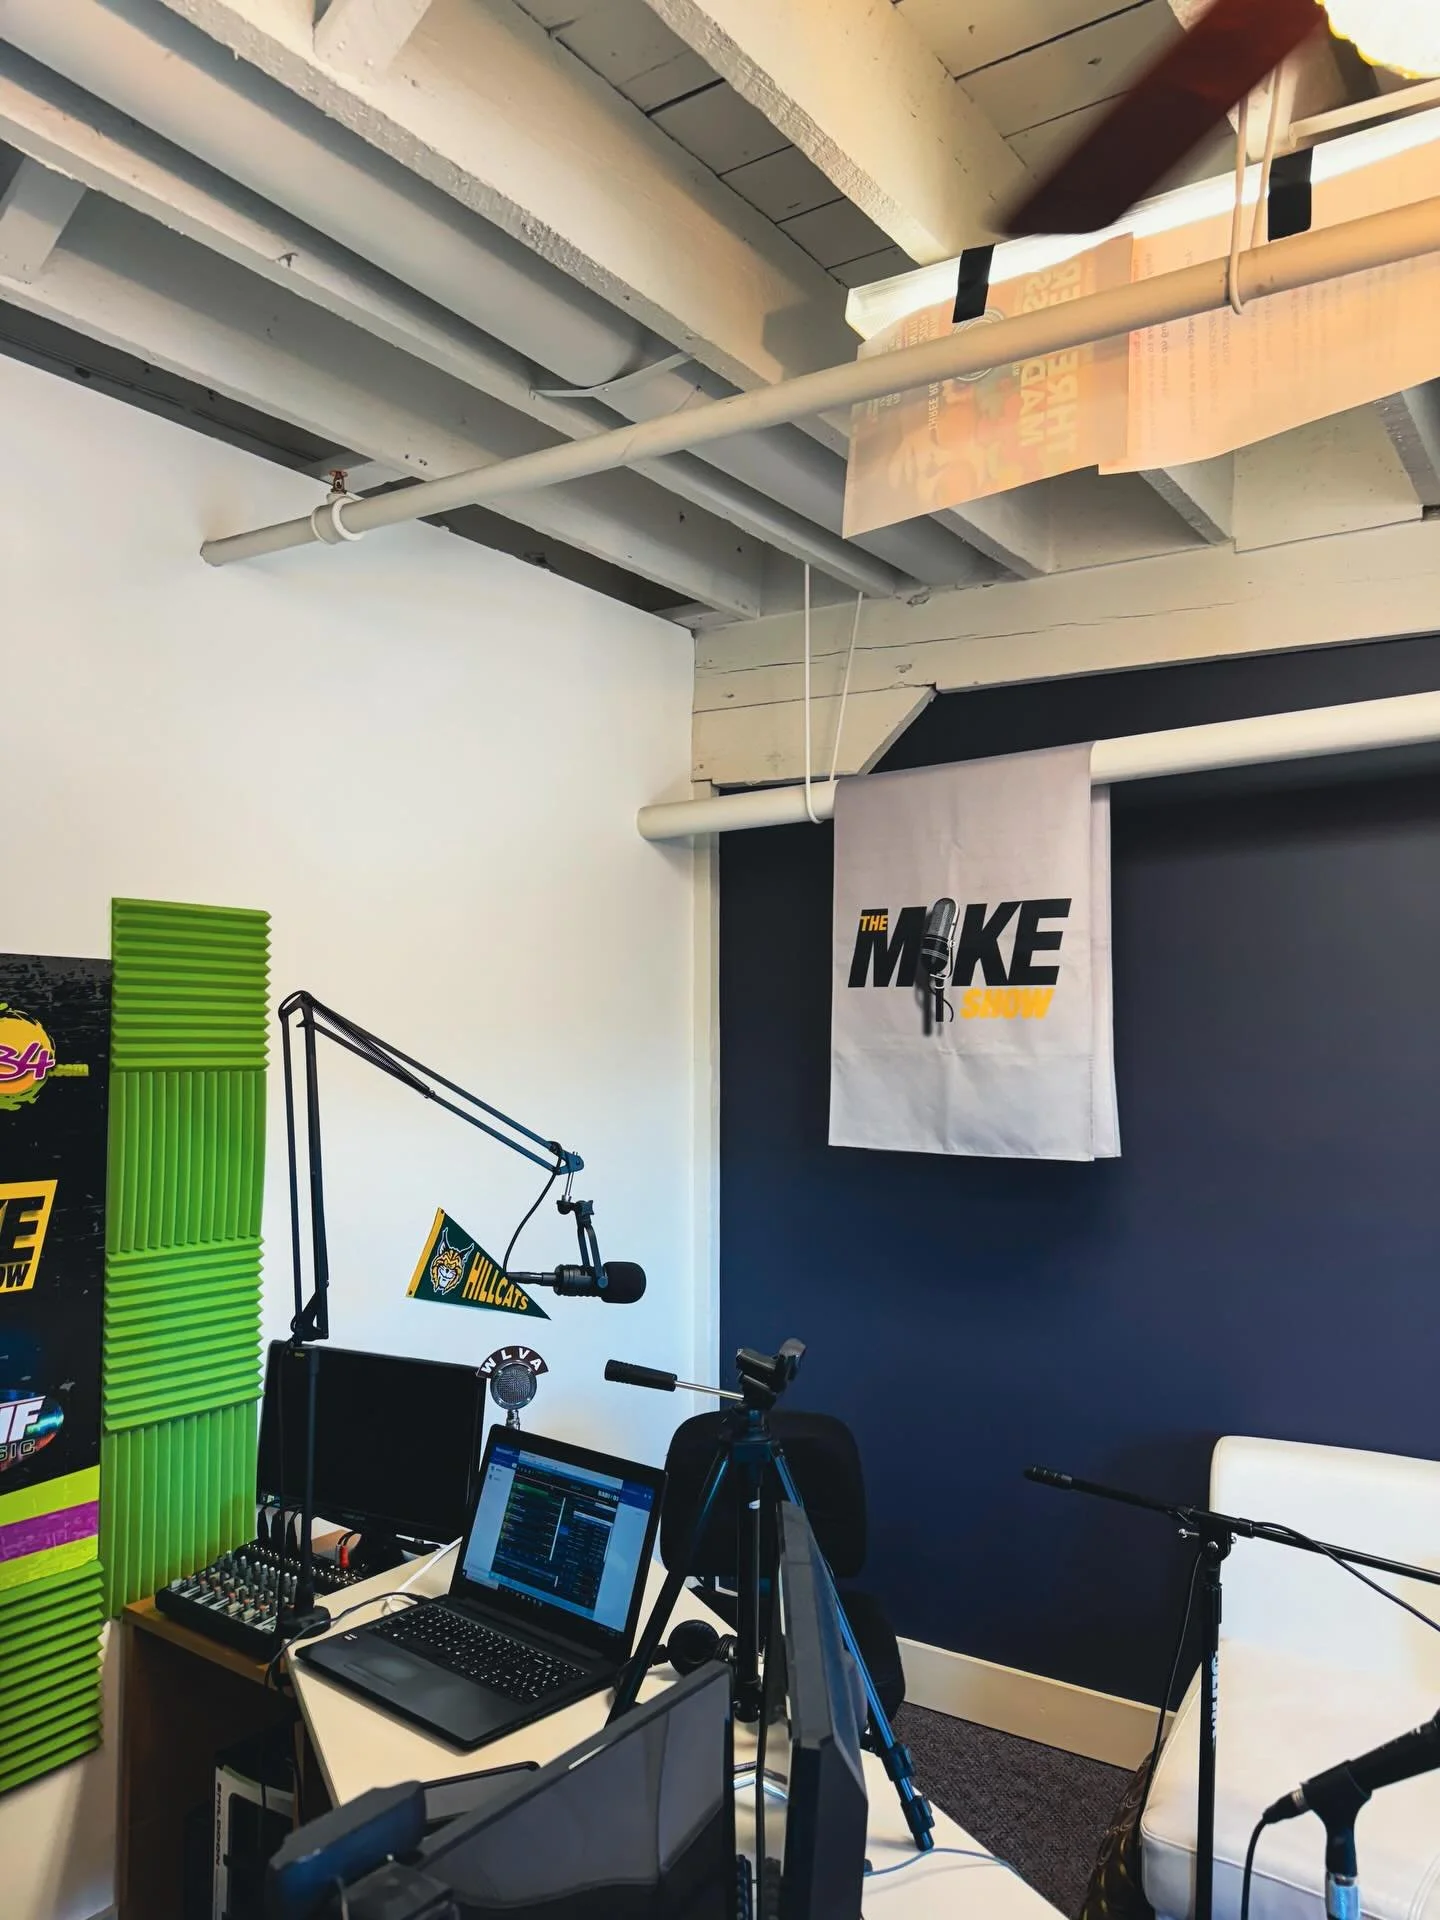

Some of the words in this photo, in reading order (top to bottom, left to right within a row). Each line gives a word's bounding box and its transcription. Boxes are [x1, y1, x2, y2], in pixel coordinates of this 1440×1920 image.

[860, 913, 888, 932] THE
[960, 986, 1055, 1020] SHOW
[461, 1251, 529, 1311] HILLCATS
[480, 1347, 543, 1374] WLVA
